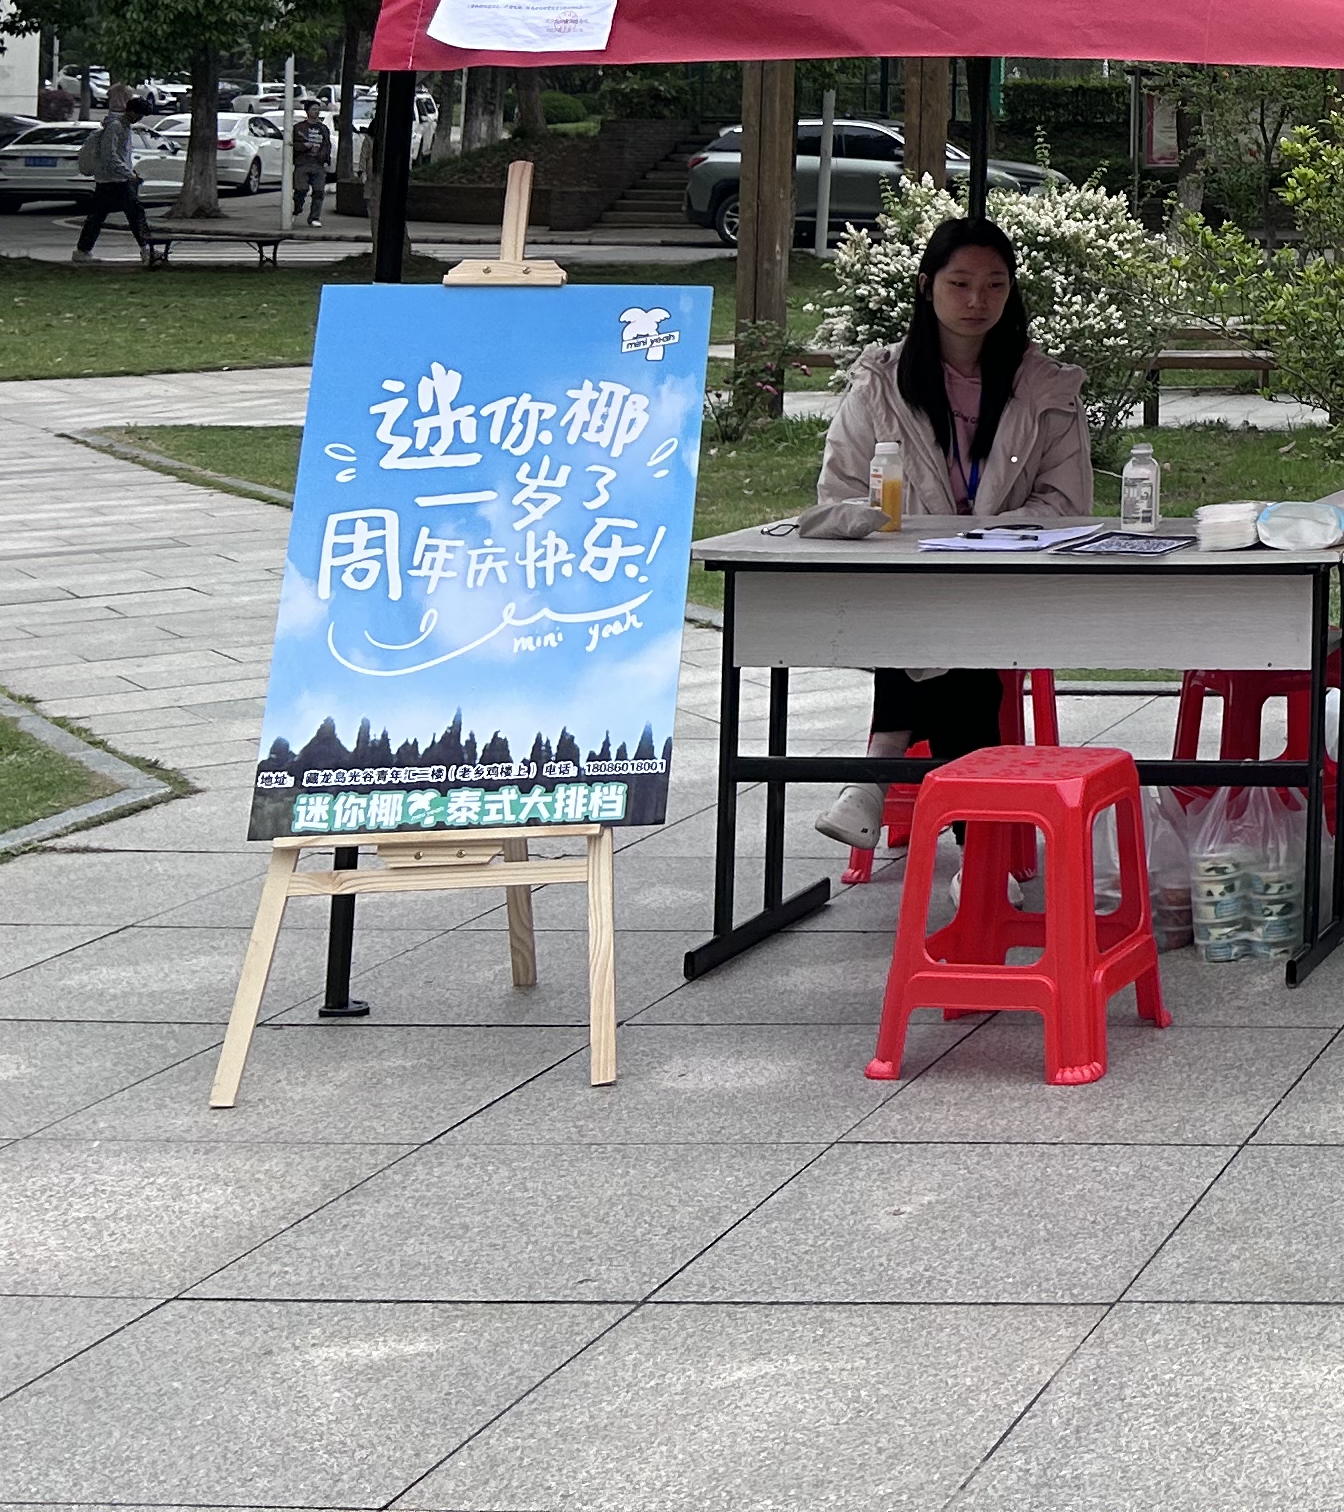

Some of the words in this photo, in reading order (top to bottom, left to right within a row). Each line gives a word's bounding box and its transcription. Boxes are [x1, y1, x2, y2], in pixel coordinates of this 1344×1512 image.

[370, 362, 651, 472] 迷你椰
[415, 456, 611, 531] 一岁了
[514, 625, 563, 654] mini
[294, 791, 405, 831] 迷你椰
[446, 783, 628, 824] 泰式大排档
